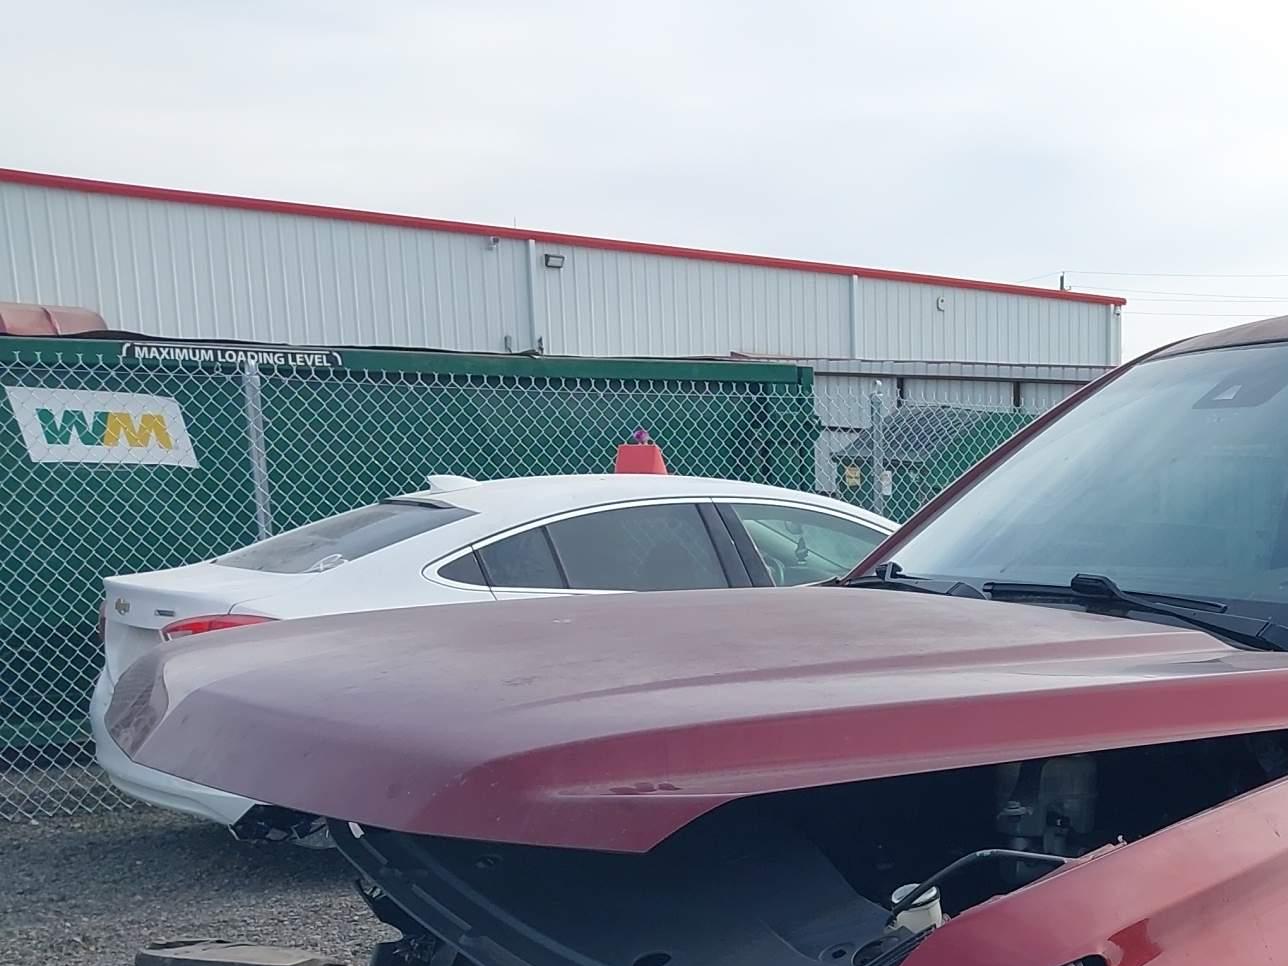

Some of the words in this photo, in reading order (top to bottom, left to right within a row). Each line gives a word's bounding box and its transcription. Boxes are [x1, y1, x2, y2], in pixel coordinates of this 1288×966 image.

[134, 346, 214, 362] MAXIMUM
[217, 350, 285, 366] LOADING
[288, 353, 332, 366] LEVEL
[36, 408, 173, 451] WM
